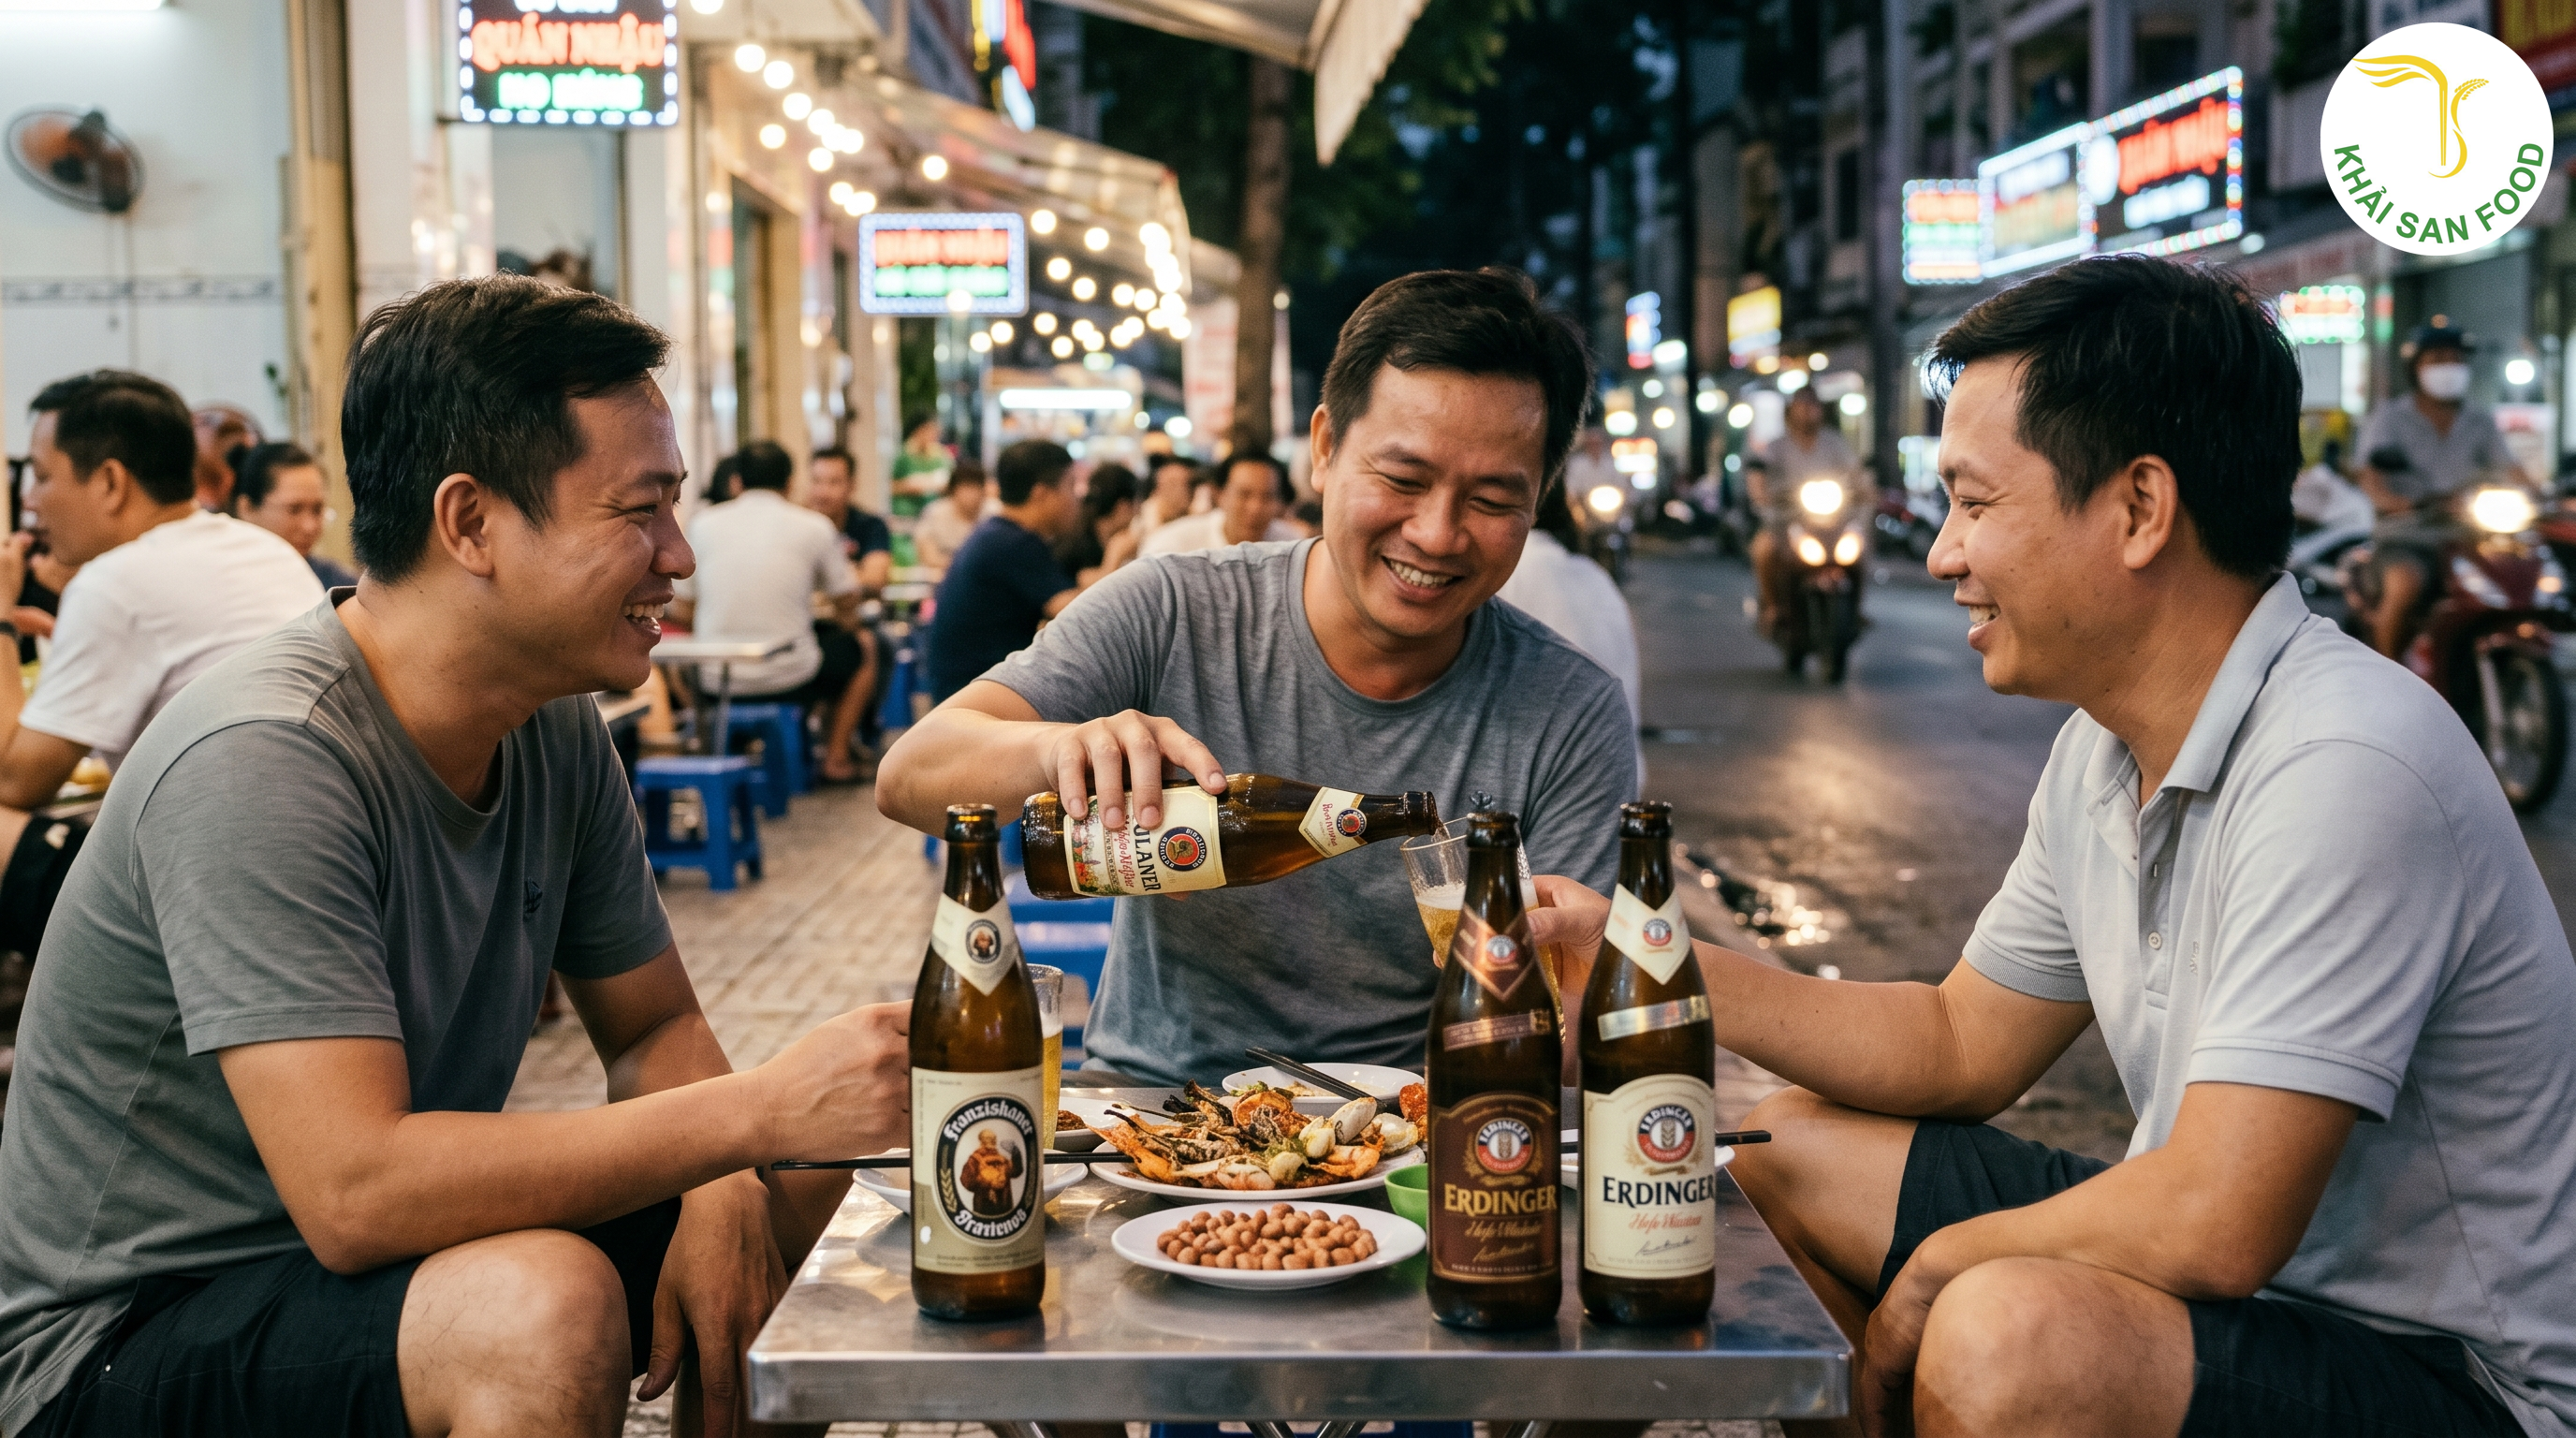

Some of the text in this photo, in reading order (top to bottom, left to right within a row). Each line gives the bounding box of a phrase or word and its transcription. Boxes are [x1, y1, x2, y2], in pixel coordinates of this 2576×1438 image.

[1133, 823, 1162, 892] ULANER
[1443, 1182, 1558, 1218] ERDINGER
[1603, 1174, 1715, 1209] ERDINGER
